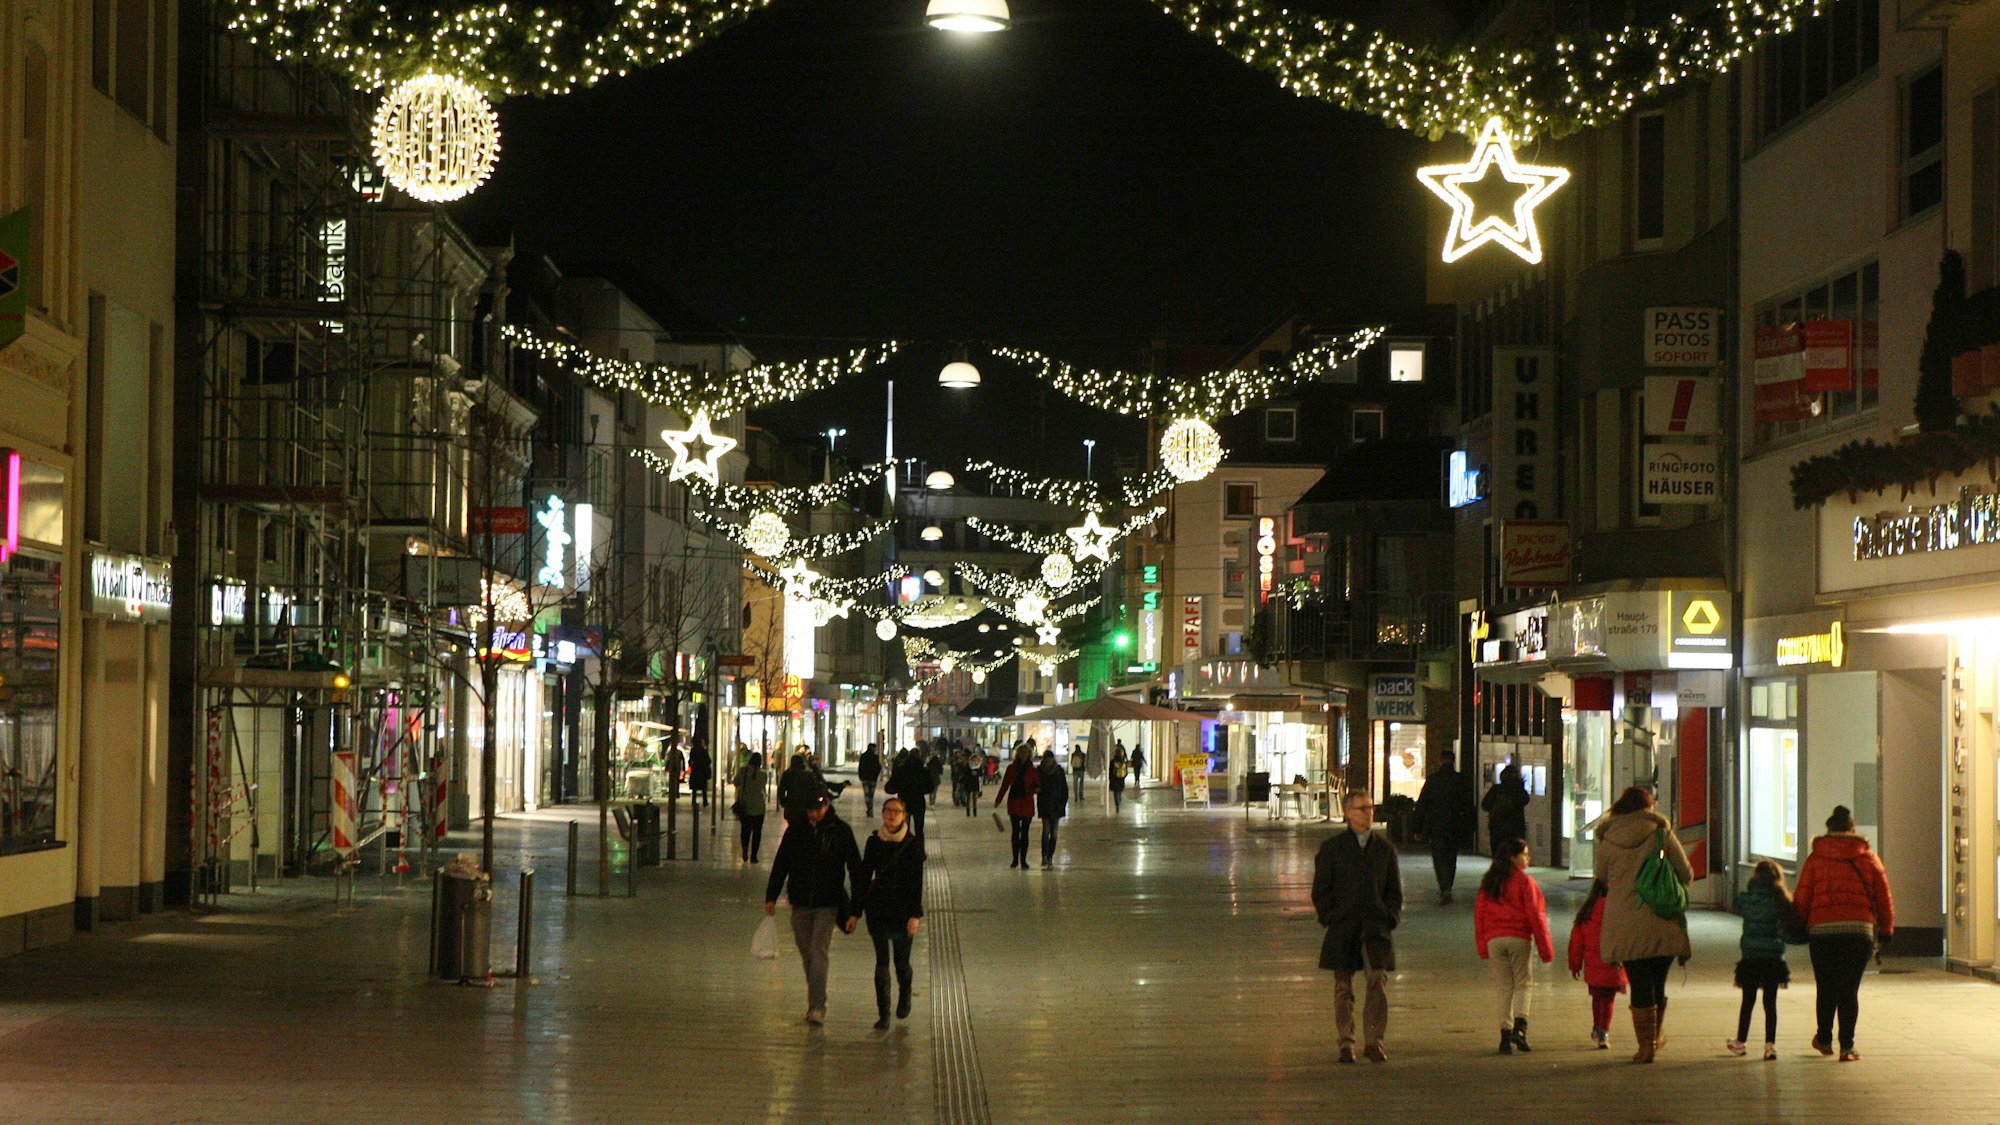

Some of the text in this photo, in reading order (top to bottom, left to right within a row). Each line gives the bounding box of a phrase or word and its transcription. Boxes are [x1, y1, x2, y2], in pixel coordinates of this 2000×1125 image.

[1654, 311, 1710, 331] PASS
[1654, 332, 1710, 347] FOTOS
[1654, 350, 1708, 362] SOFORT
[1648, 477, 1715, 496] HÄUSER
[1184, 596, 1201, 648] PFAFF
[1608, 624, 1659, 635] straße 179
[1377, 678, 1413, 695] back
[1375, 700, 1416, 716] WERK
